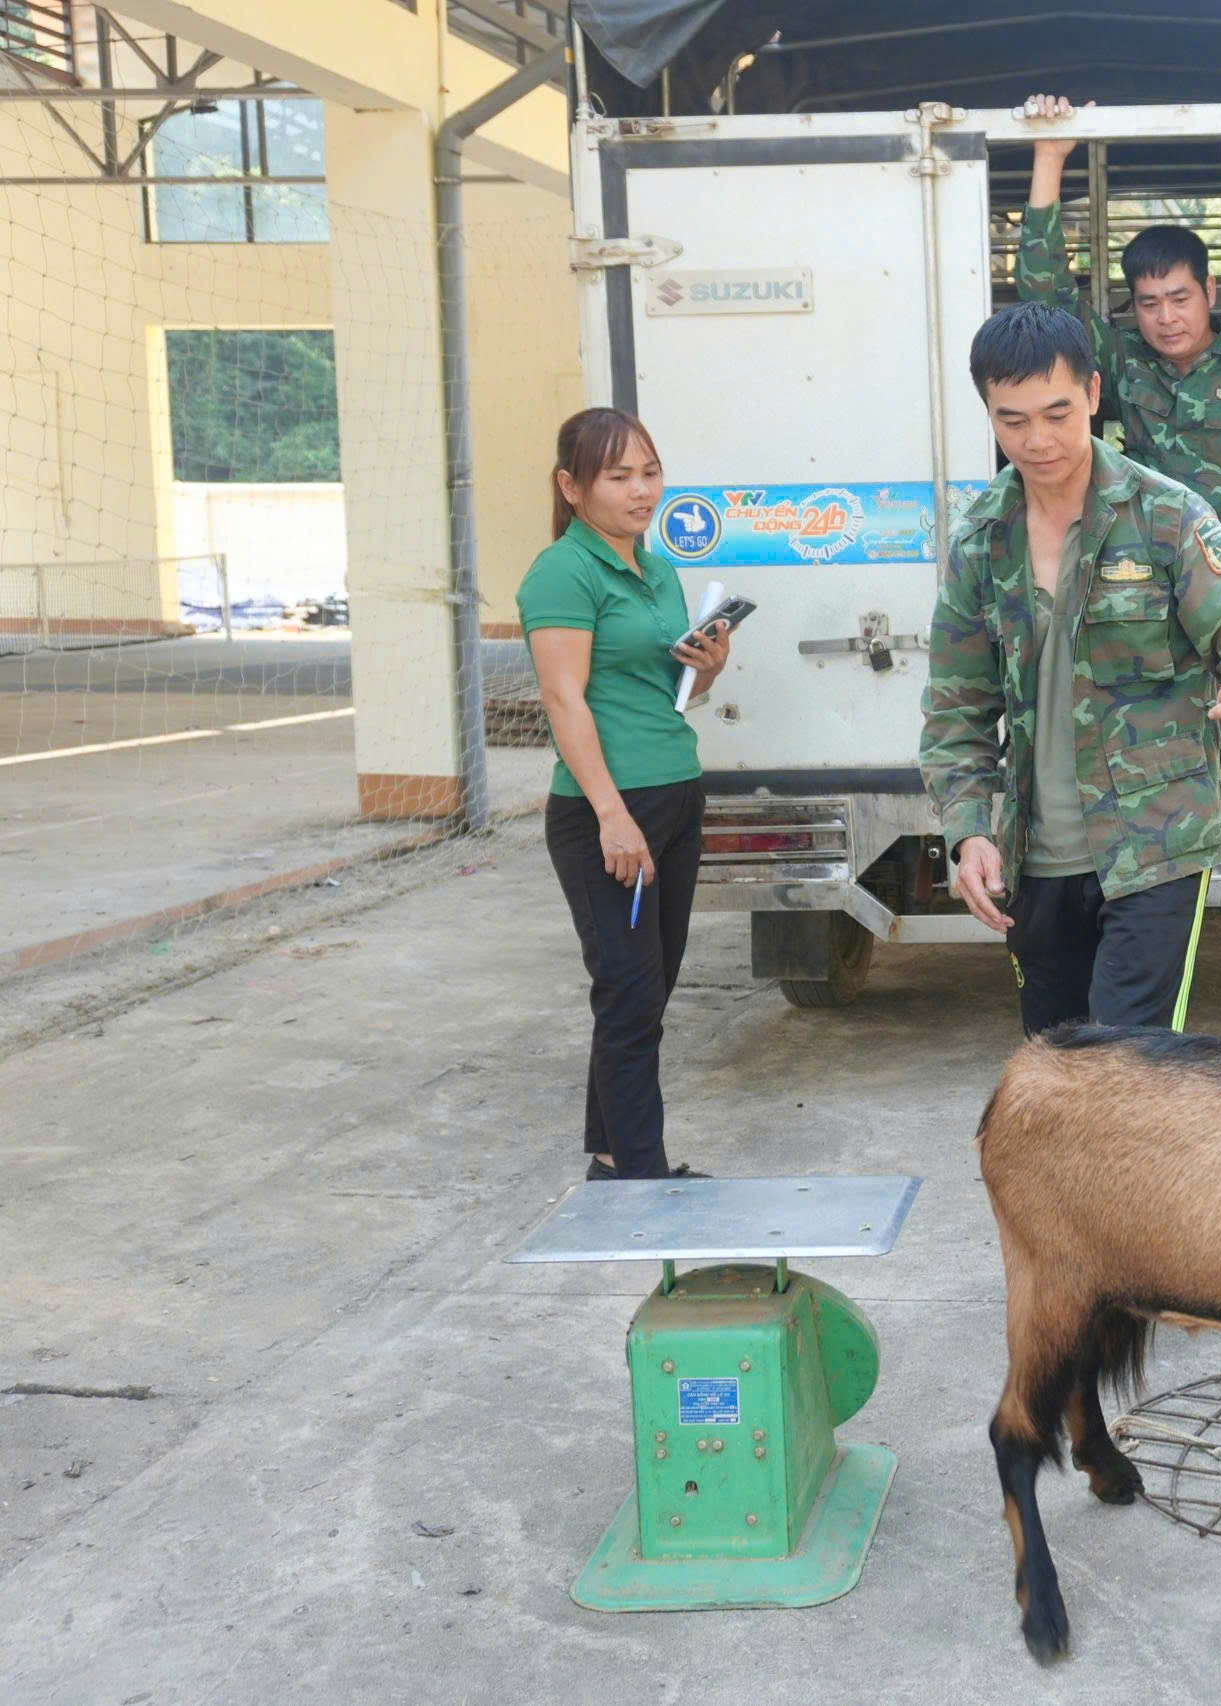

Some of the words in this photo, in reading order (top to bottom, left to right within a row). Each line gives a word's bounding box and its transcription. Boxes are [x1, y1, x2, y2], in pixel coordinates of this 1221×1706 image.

[688, 280, 805, 301] SUZUKI
[724, 491, 765, 506] VTV
[753, 518, 801, 533] ĐỘNG
[800, 504, 846, 536] 24h
[674, 535, 695, 548] LET'S
